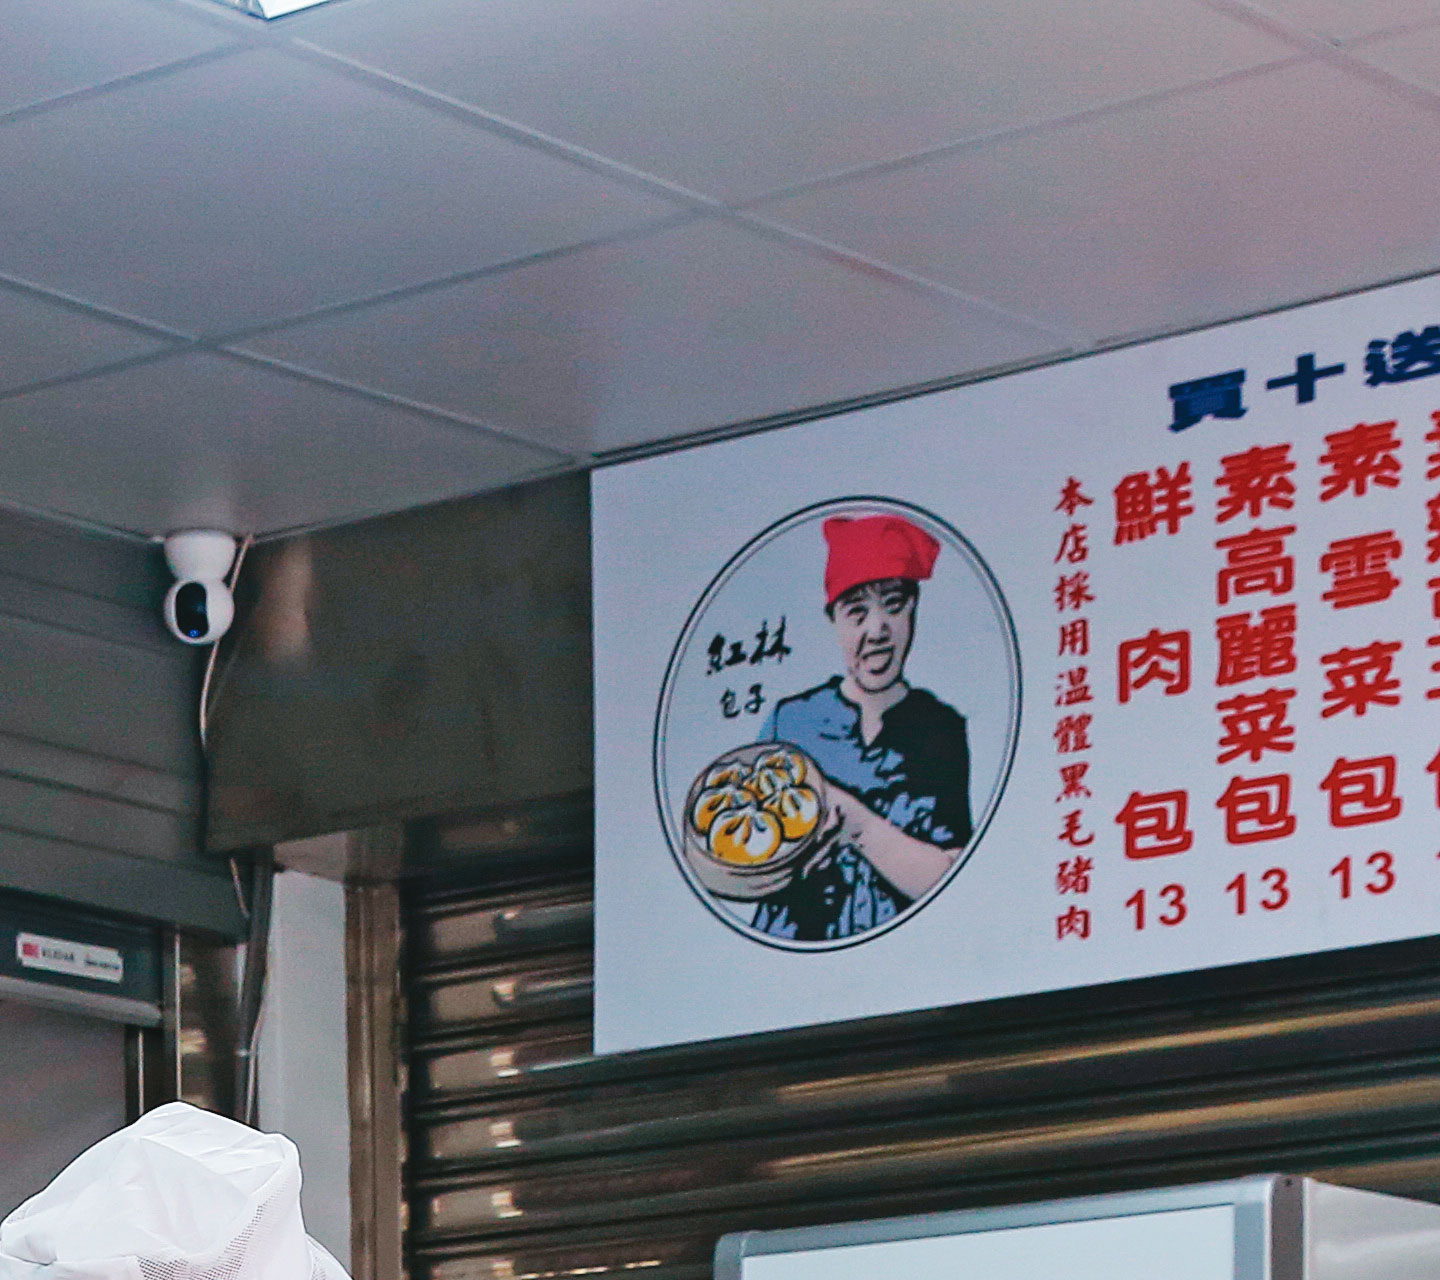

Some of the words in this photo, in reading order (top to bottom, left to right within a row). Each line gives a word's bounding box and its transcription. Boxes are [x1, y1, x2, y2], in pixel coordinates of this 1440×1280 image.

[1113, 461, 1195, 861] 鮮肉包
[1215, 443, 1297, 846] 素高麗菜包
[1319, 419, 1403, 828] 素雪菜包
[1125, 883, 1188, 931] 13
[1225, 867, 1290, 916] 13
[1329, 850, 1396, 900] 13
